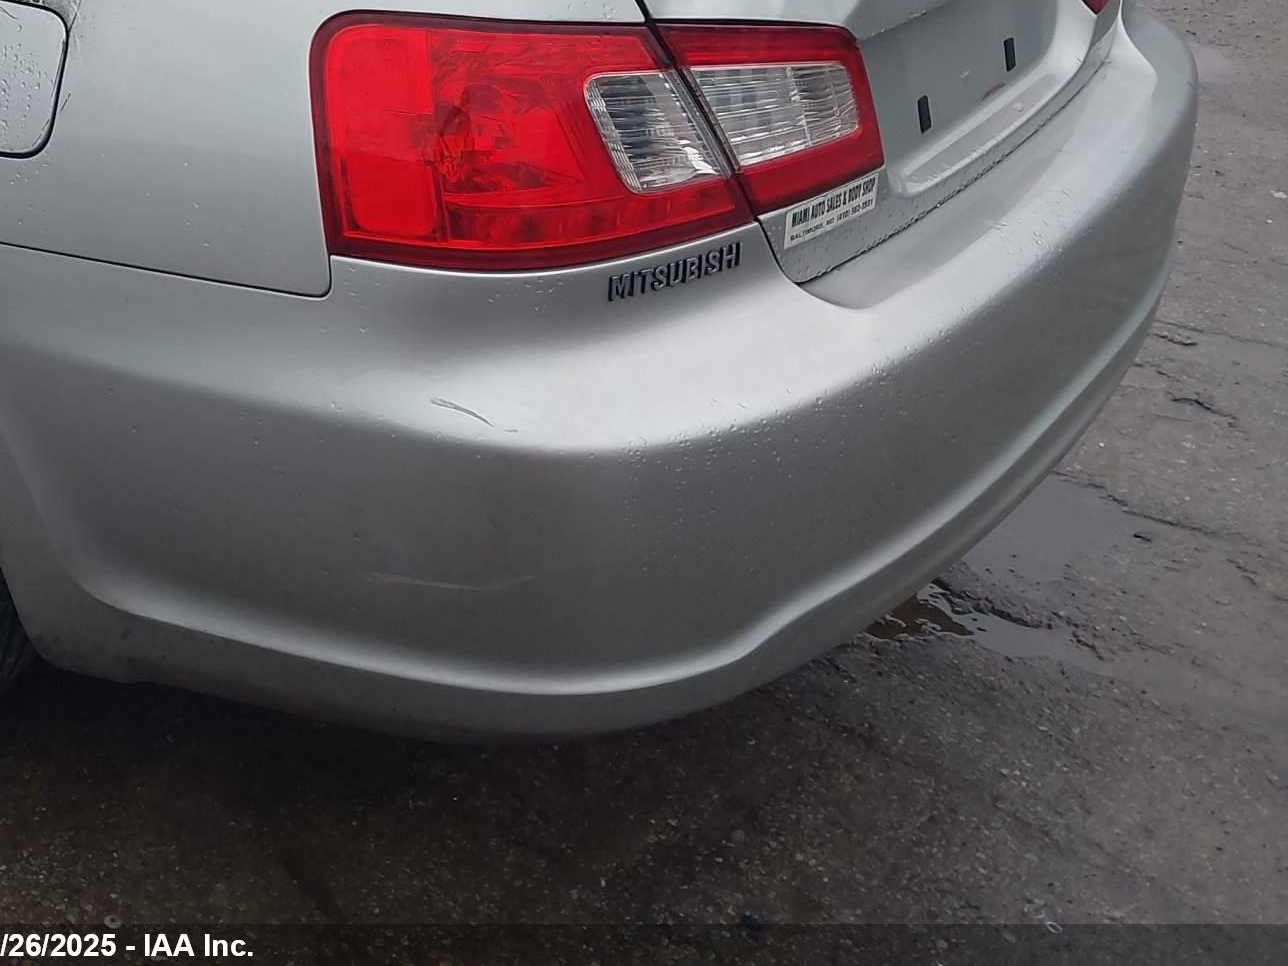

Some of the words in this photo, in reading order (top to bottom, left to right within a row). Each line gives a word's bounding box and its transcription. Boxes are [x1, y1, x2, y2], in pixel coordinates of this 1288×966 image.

[791, 206, 811, 228] MIAMI
[810, 200, 826, 219] AUTO
[826, 192, 842, 213] SALES
[842, 190, 847, 205] &
[848, 183, 862, 203] BODY
[862, 177, 876, 196] SHOP
[826, 217, 835, 226] MD
[608, 241, 744, 302] MITSUBISHI
